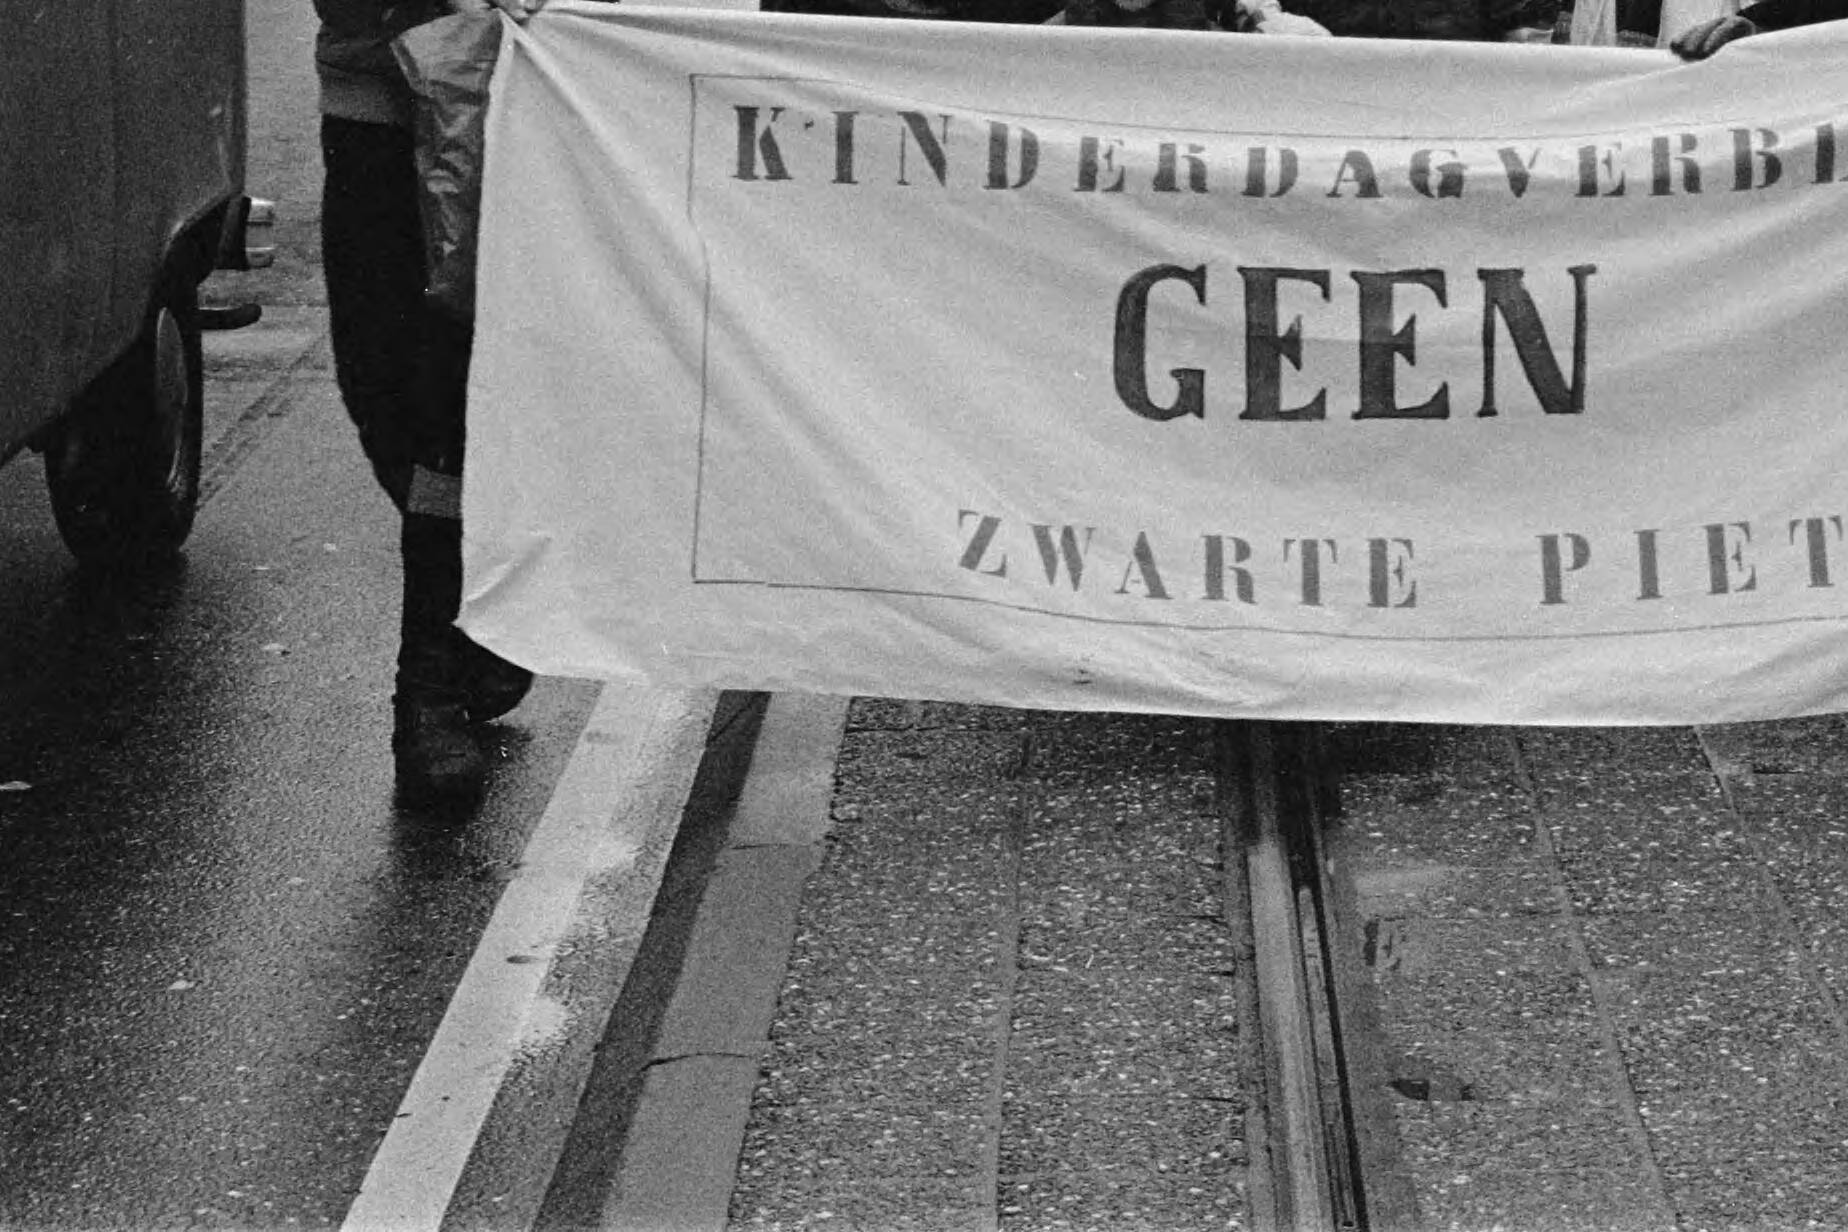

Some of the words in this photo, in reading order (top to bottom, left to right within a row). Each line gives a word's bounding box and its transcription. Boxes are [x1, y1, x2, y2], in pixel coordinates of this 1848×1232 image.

[1112, 262, 1600, 423] GEEN
[954, 508, 1420, 610] ZWARTE
[1535, 513, 1848, 606] PIET
